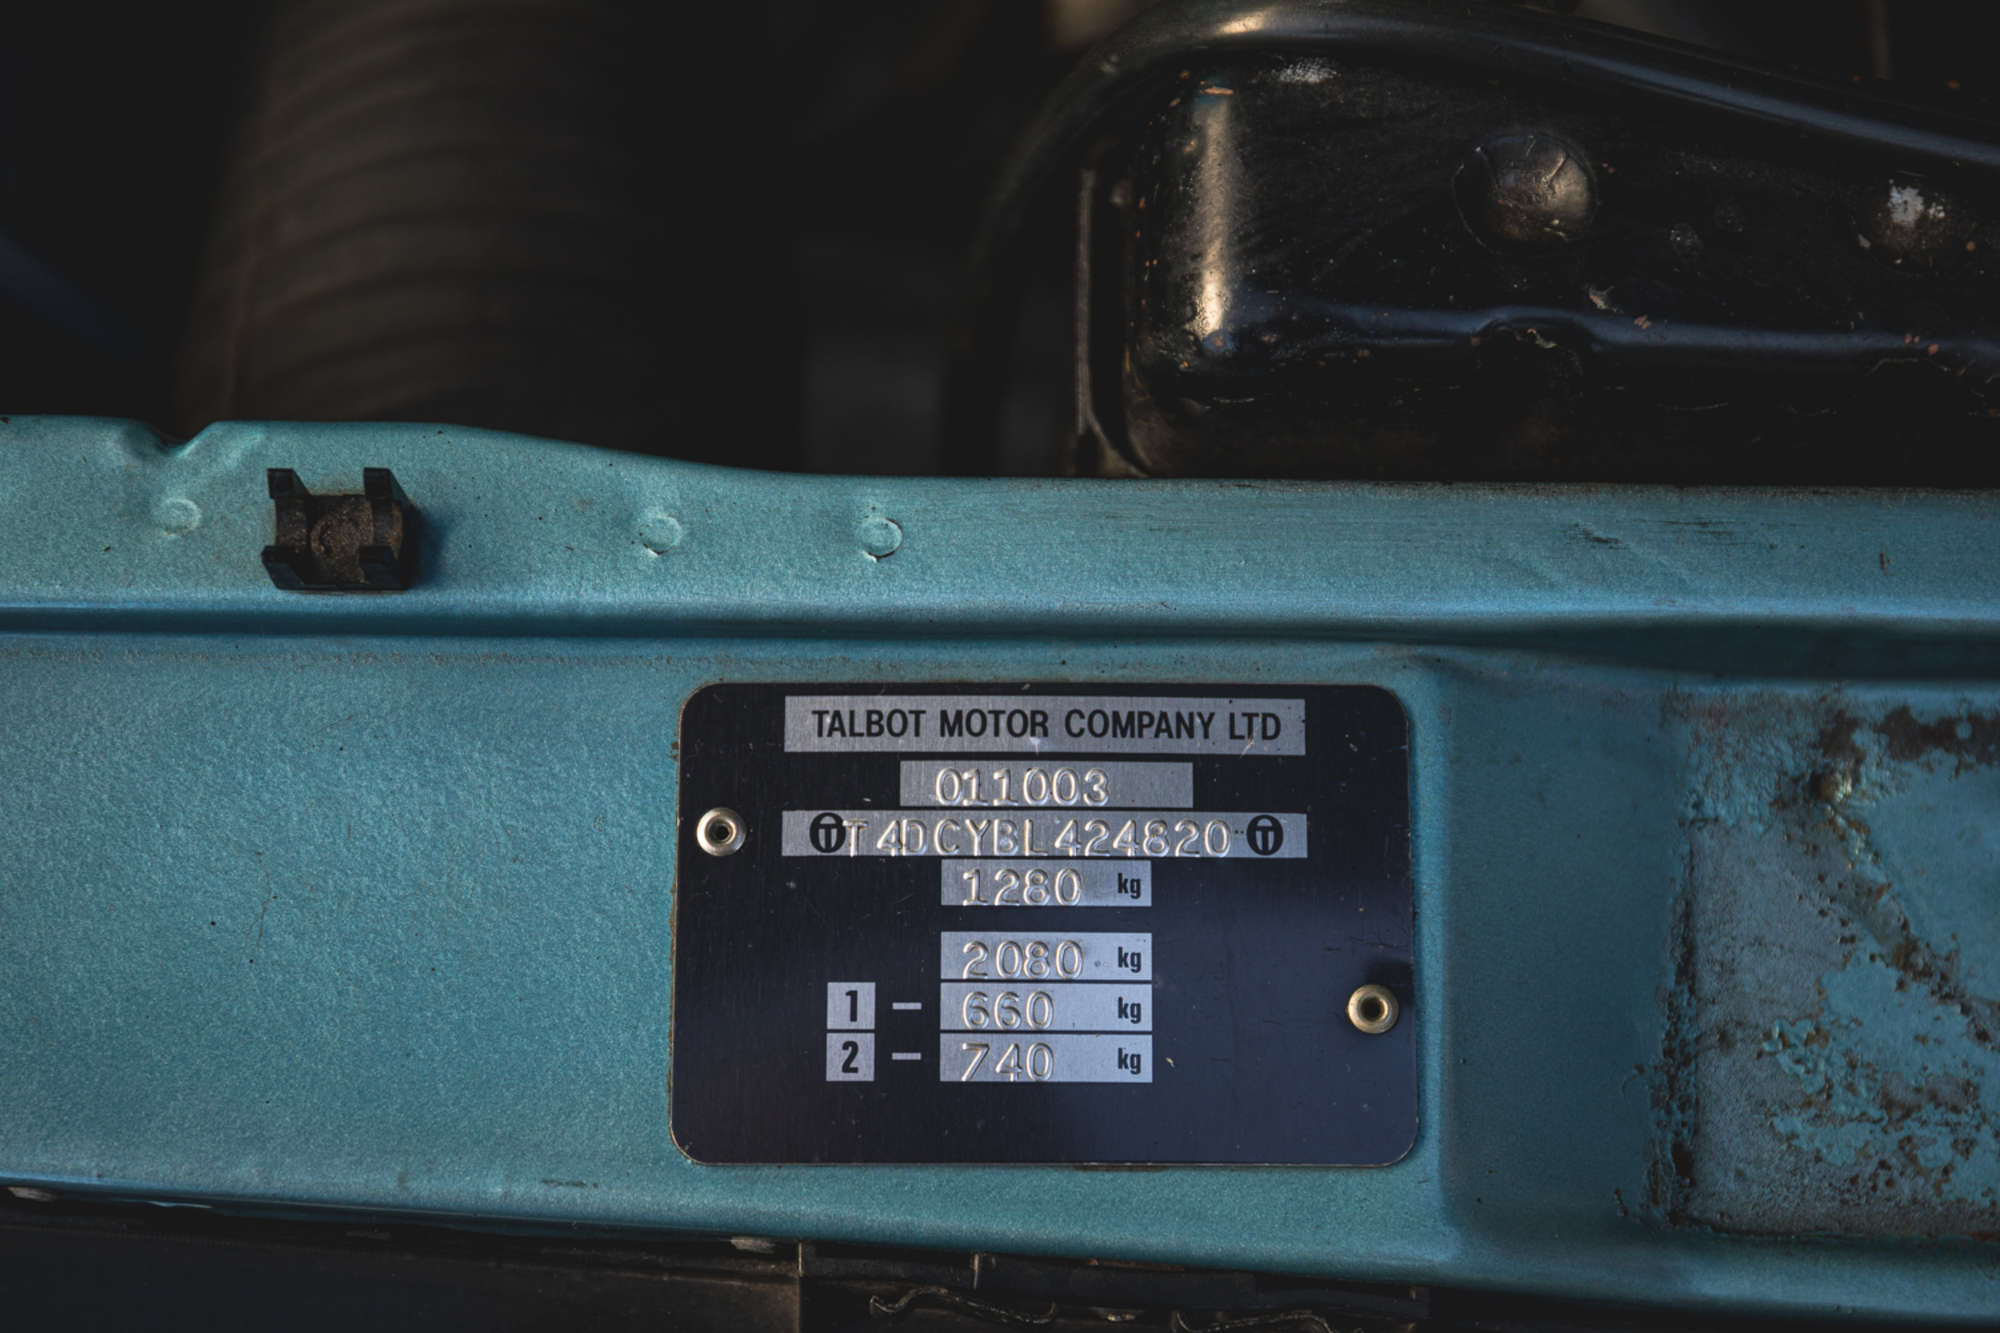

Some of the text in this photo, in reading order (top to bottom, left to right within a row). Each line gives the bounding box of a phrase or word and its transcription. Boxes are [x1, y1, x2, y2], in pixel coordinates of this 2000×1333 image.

[812, 709, 1281, 740] TALBOT MOTOR COMPANY LTD
[935, 767, 1111, 807] 011003
[962, 867, 1141, 906] 1280 kg
[962, 940, 1141, 979] 2080 kg
[845, 990, 858, 1022] 1
[962, 990, 1055, 1030] 660
[1118, 997, 1141, 1023] kg
[841, 1041, 859, 1073] 2
[961, 1042, 1055, 1082] 740
[1118, 1048, 1141, 1074] kg
